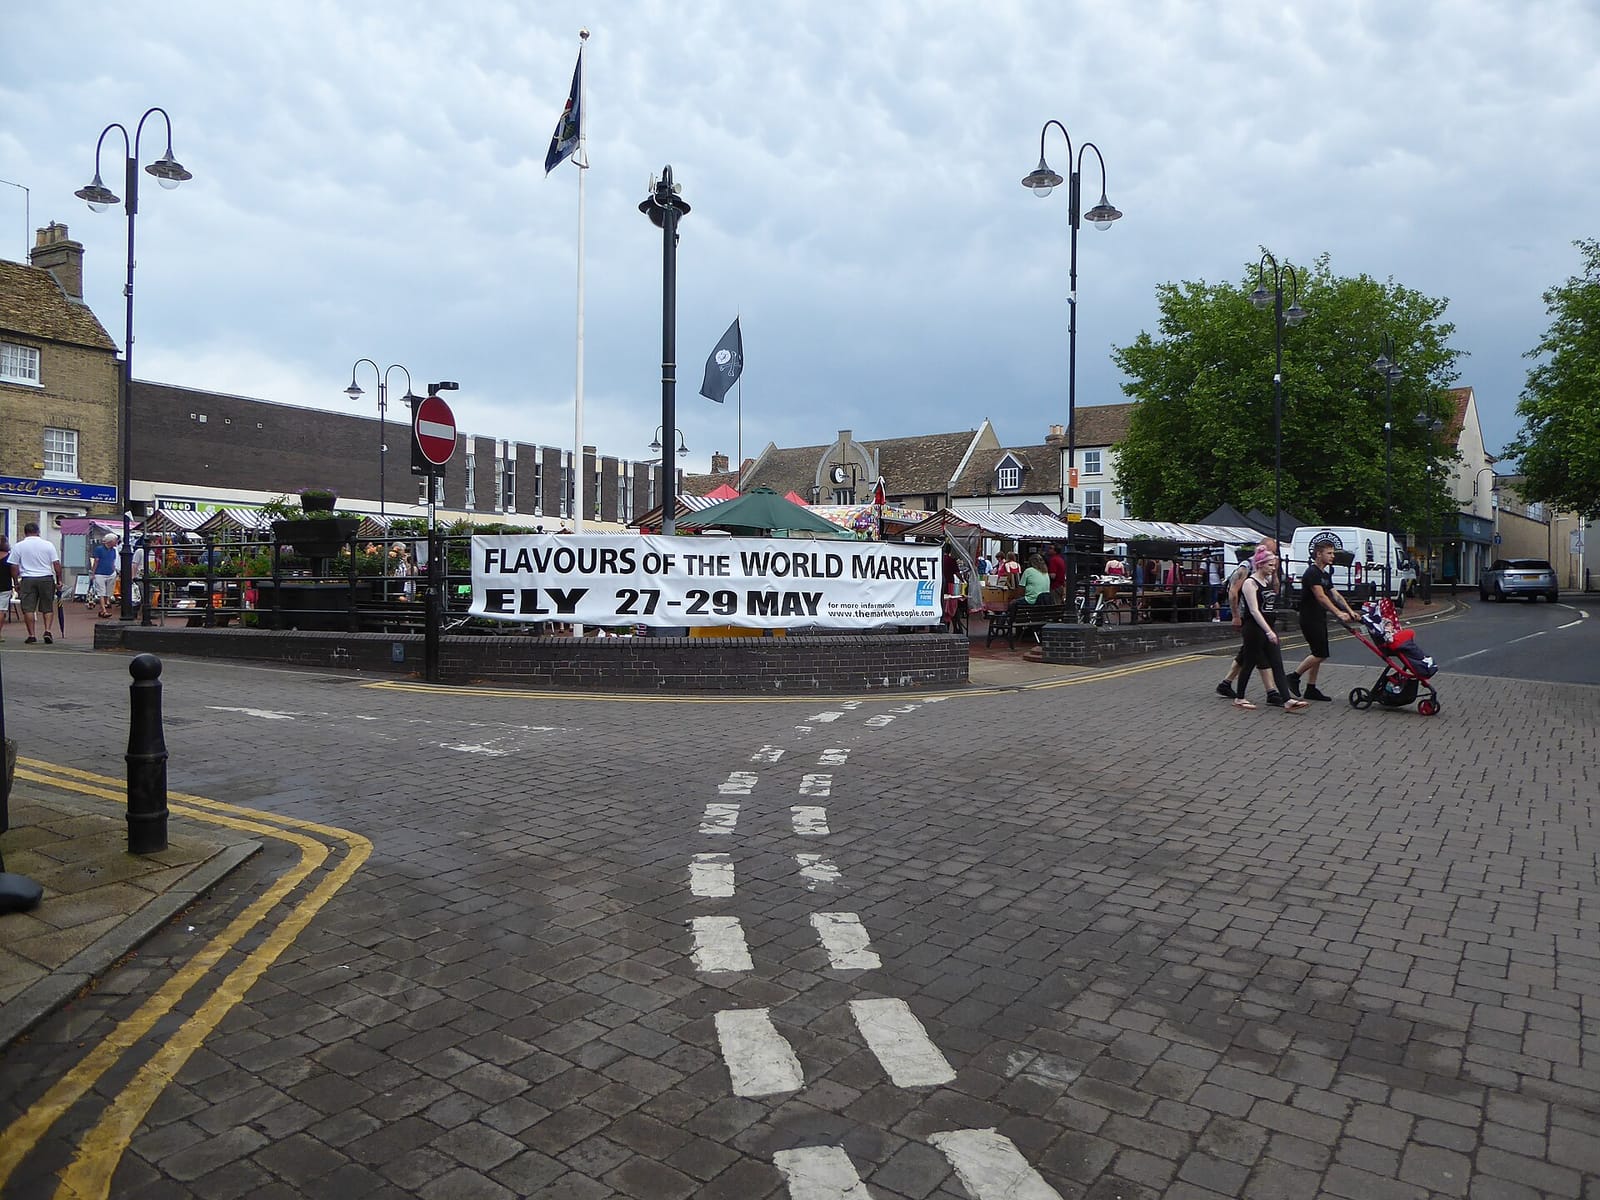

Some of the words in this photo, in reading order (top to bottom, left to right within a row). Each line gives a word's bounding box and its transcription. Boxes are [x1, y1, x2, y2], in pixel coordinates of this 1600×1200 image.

[485, 548, 636, 574] FLAVOURS
[642, 552, 676, 575] OF
[683, 555, 730, 577] THE
[740, 552, 843, 578] WORLD
[852, 555, 939, 580] MARKET
[484, 588, 590, 614] ELY
[747, 590, 824, 617] MAY
[828, 609, 935, 619] www.themarketpeople.com
